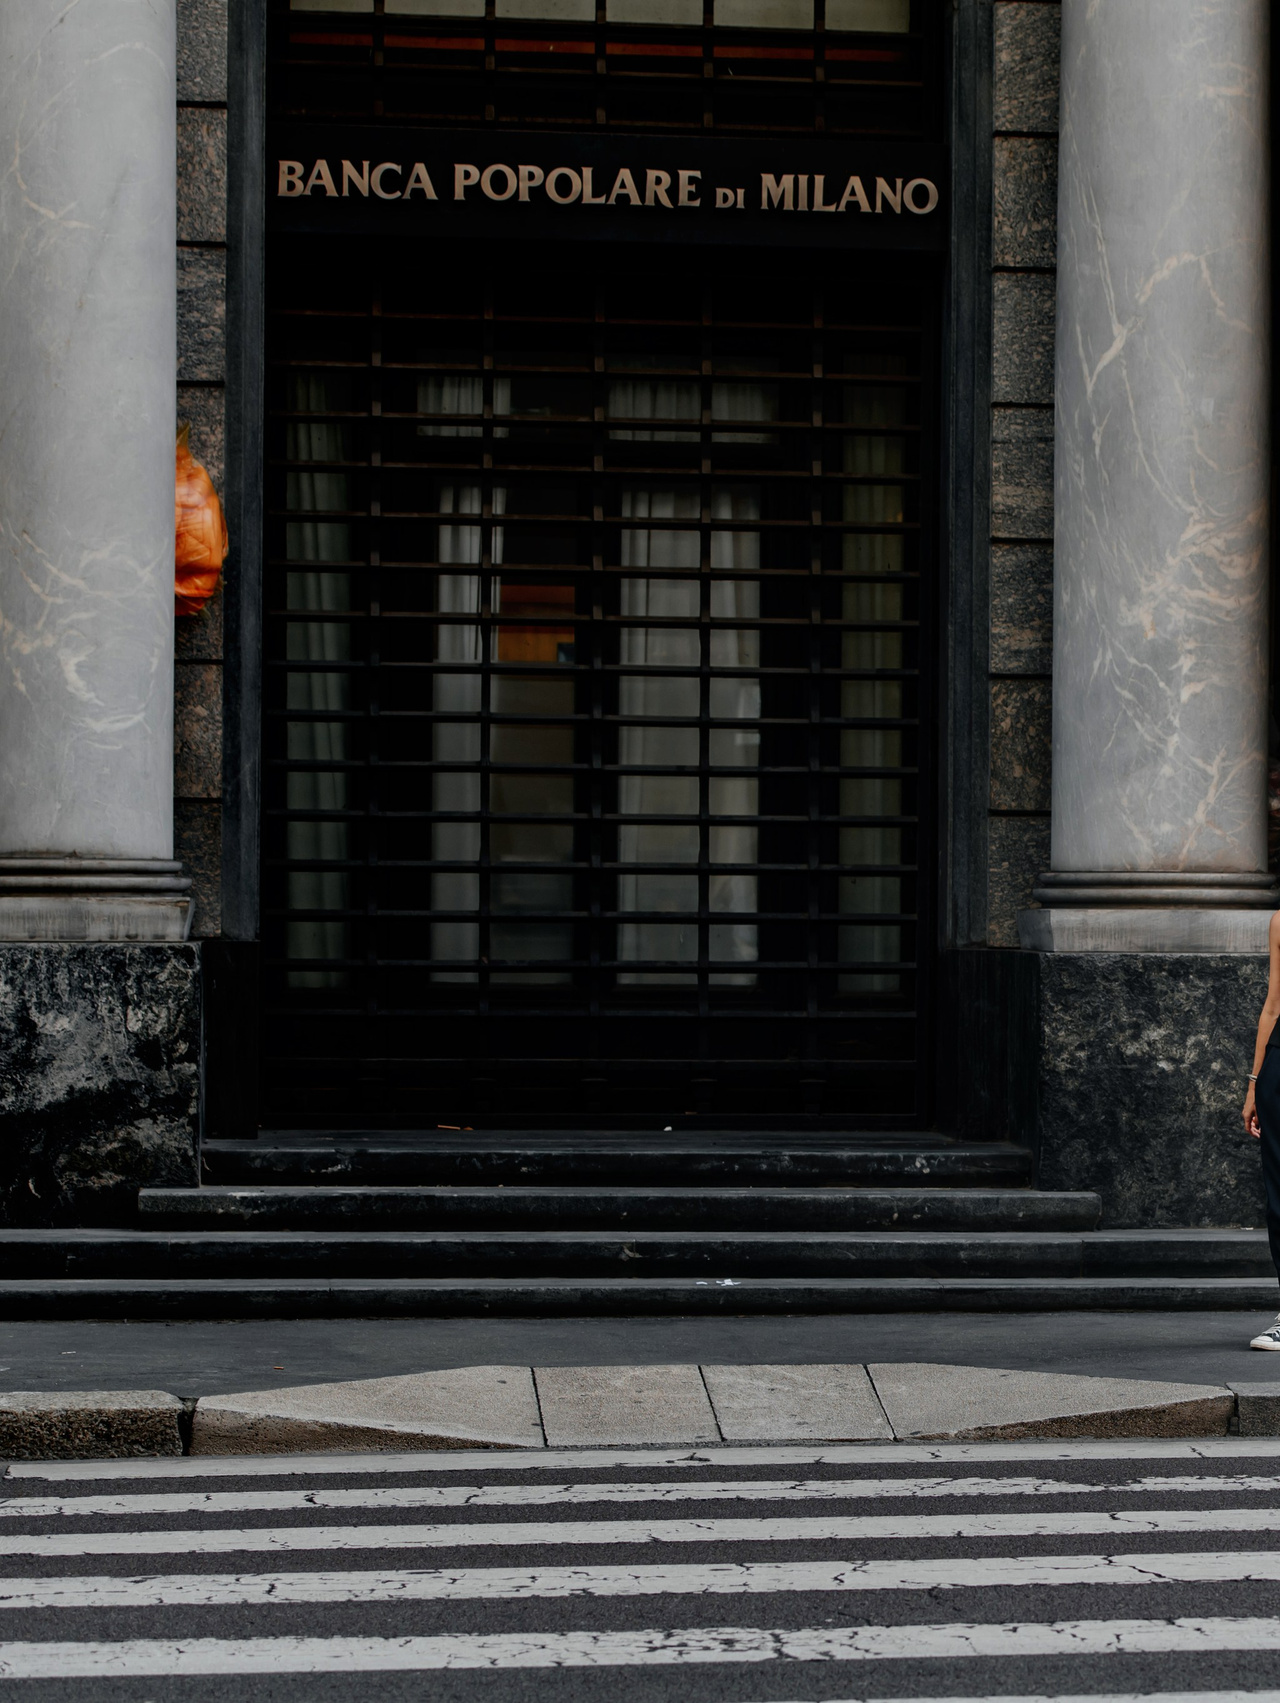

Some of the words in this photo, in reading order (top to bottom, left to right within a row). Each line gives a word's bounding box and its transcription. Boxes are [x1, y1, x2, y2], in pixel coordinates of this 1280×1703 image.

[277, 159, 438, 201] BANCA
[453, 163, 702, 209] POPOLARE
[715, 188, 746, 209] DI
[760, 173, 939, 215] MILANO
